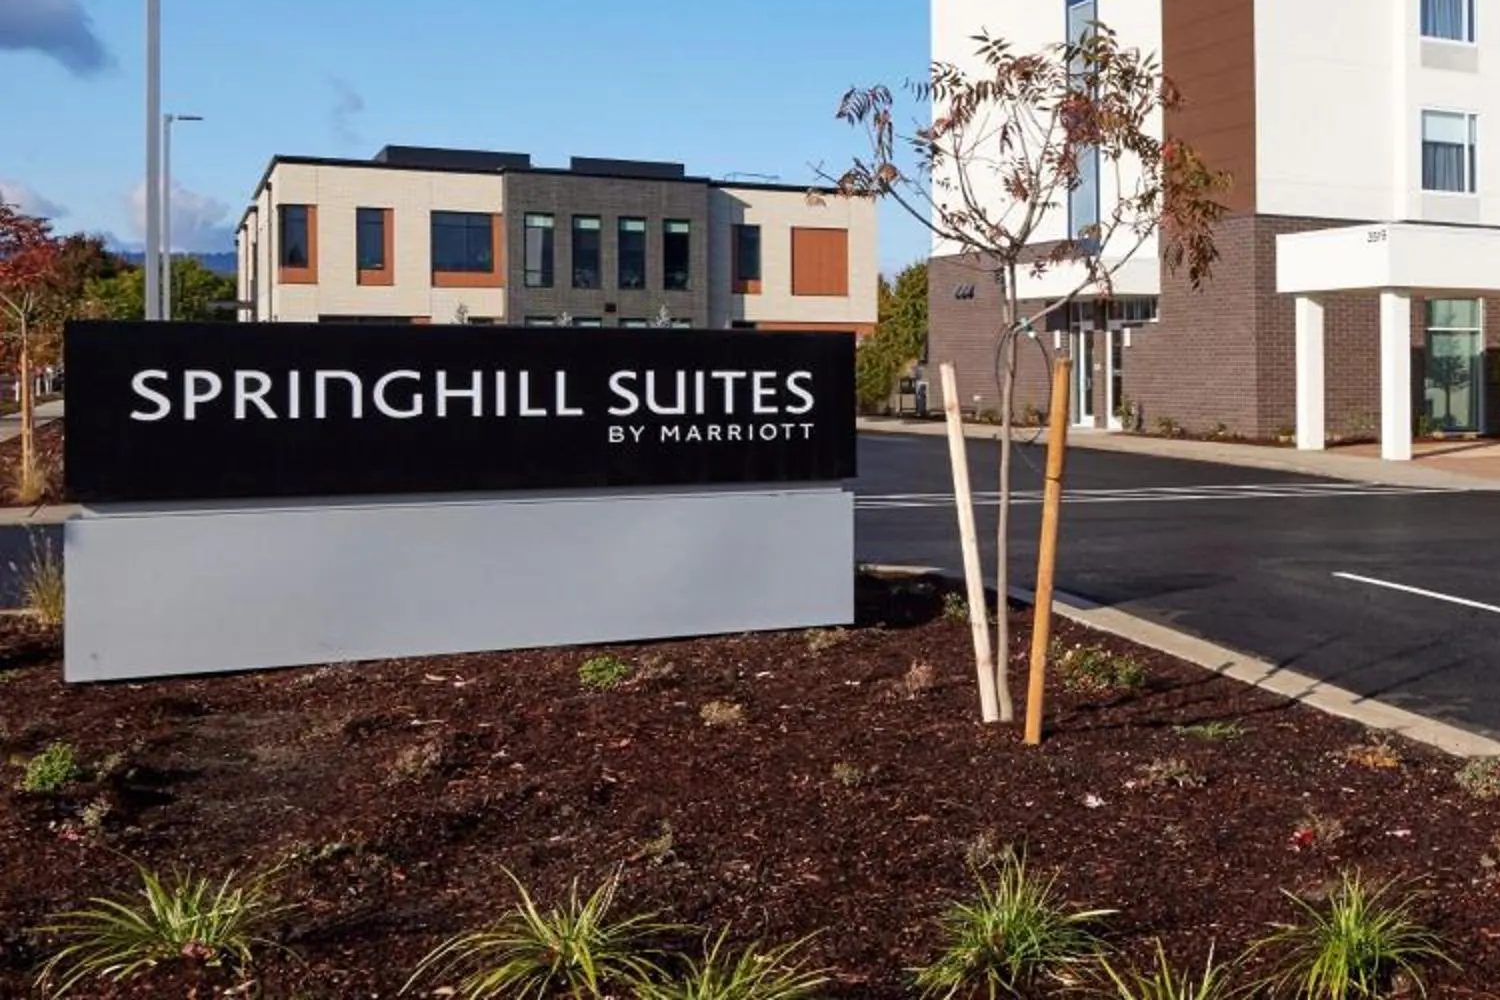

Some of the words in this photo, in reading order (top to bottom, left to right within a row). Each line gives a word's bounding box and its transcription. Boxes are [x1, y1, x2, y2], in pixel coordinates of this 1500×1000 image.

[130, 369, 584, 421] SPRINGHILL
[607, 370, 814, 416] SUITES
[608, 425, 645, 443] BY
[660, 423, 814, 442] MARRIOTT
